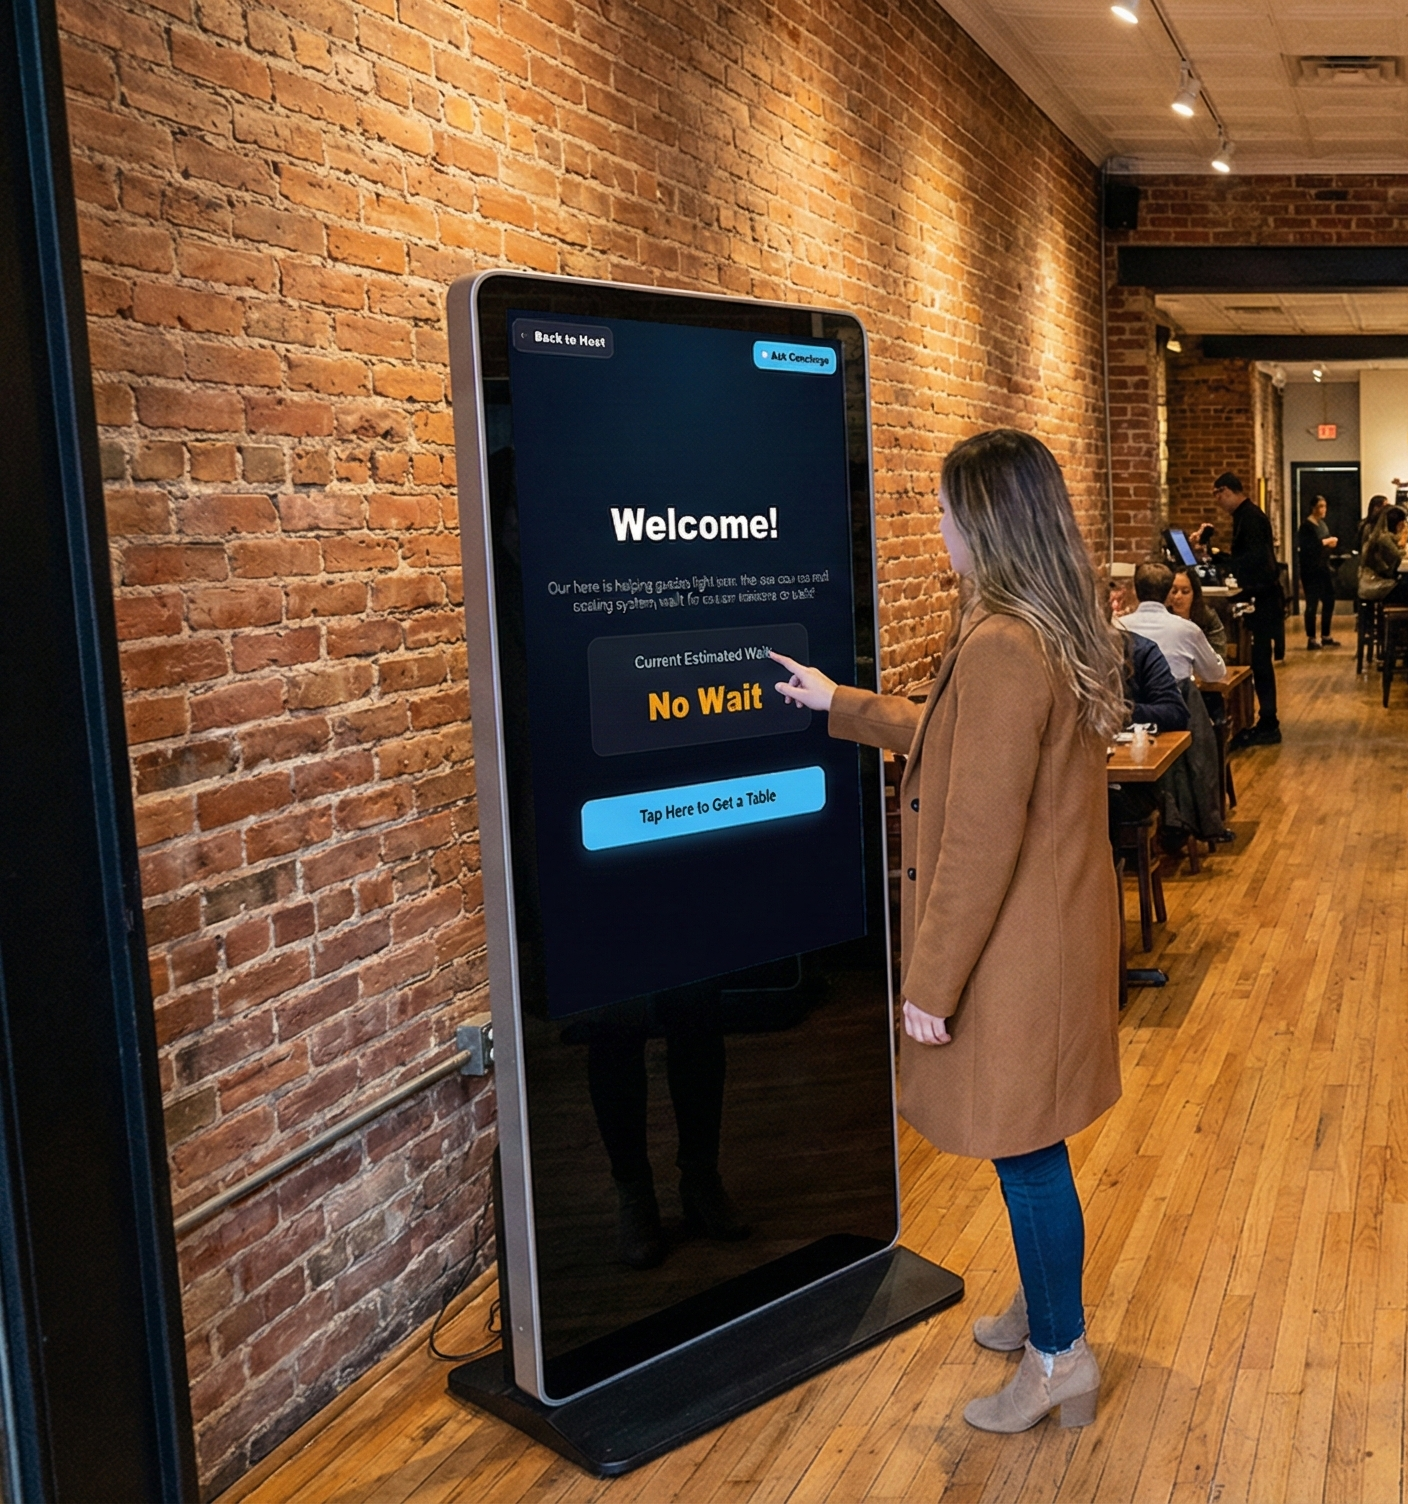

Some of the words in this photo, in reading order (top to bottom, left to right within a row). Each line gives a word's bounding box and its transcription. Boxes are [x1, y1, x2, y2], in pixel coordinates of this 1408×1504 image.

[610, 507, 778, 541] Welcome!
[547, 581, 571, 595] Our
[602, 579, 613, 593] is
[634, 653, 682, 669] Current
[684, 648, 742, 666] Estimated
[648, 691, 690, 721] No
[697, 682, 763, 715] Wait
[639, 809, 663, 825] Tap
[665, 804, 694, 819] Here
[697, 801, 710, 815] to
[712, 796, 734, 812] Get
[736, 797, 744, 808] a
[745, 788, 777, 806] Table
